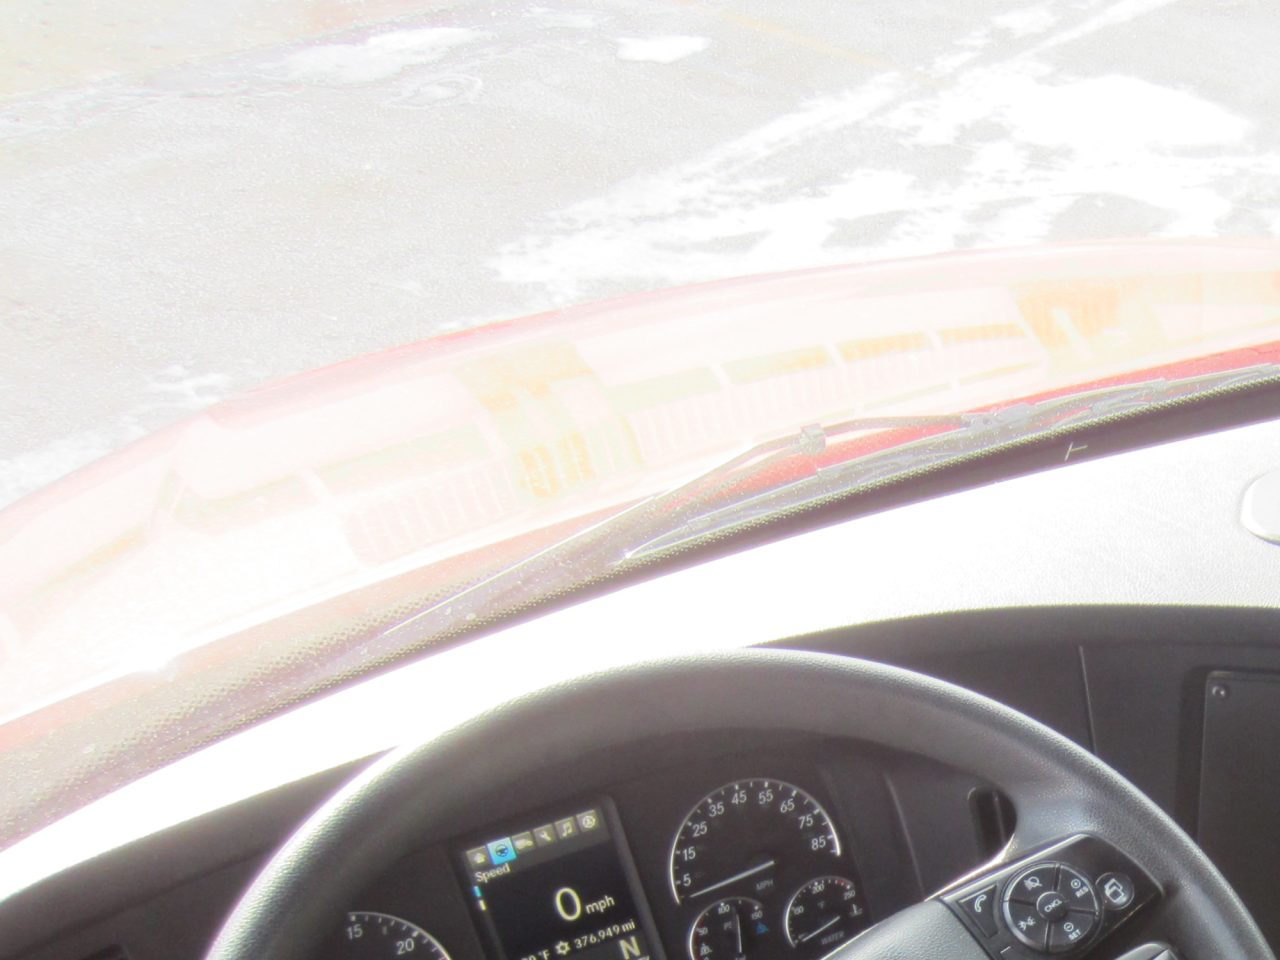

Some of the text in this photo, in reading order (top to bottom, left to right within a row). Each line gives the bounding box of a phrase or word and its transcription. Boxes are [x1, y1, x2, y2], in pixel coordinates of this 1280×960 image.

[731, 790, 747, 805] 45
[758, 789, 773, 804] 55
[708, 802, 724, 817] 35
[780, 798, 795, 813] 65
[799, 814, 813, 829] 75
[692, 821, 708, 838] 25
[811, 836, 826, 850] 85
[682, 847, 696, 861] 15
[474, 862, 511, 883] Speed
[683, 873, 692, 887] 5
[555, 887, 615, 921] 0 mph
[346, 923, 363, 940] 15
[622, 919, 636, 932] mi
[396, 937, 415, 955] 20
[619, 936, 641, 960] N
